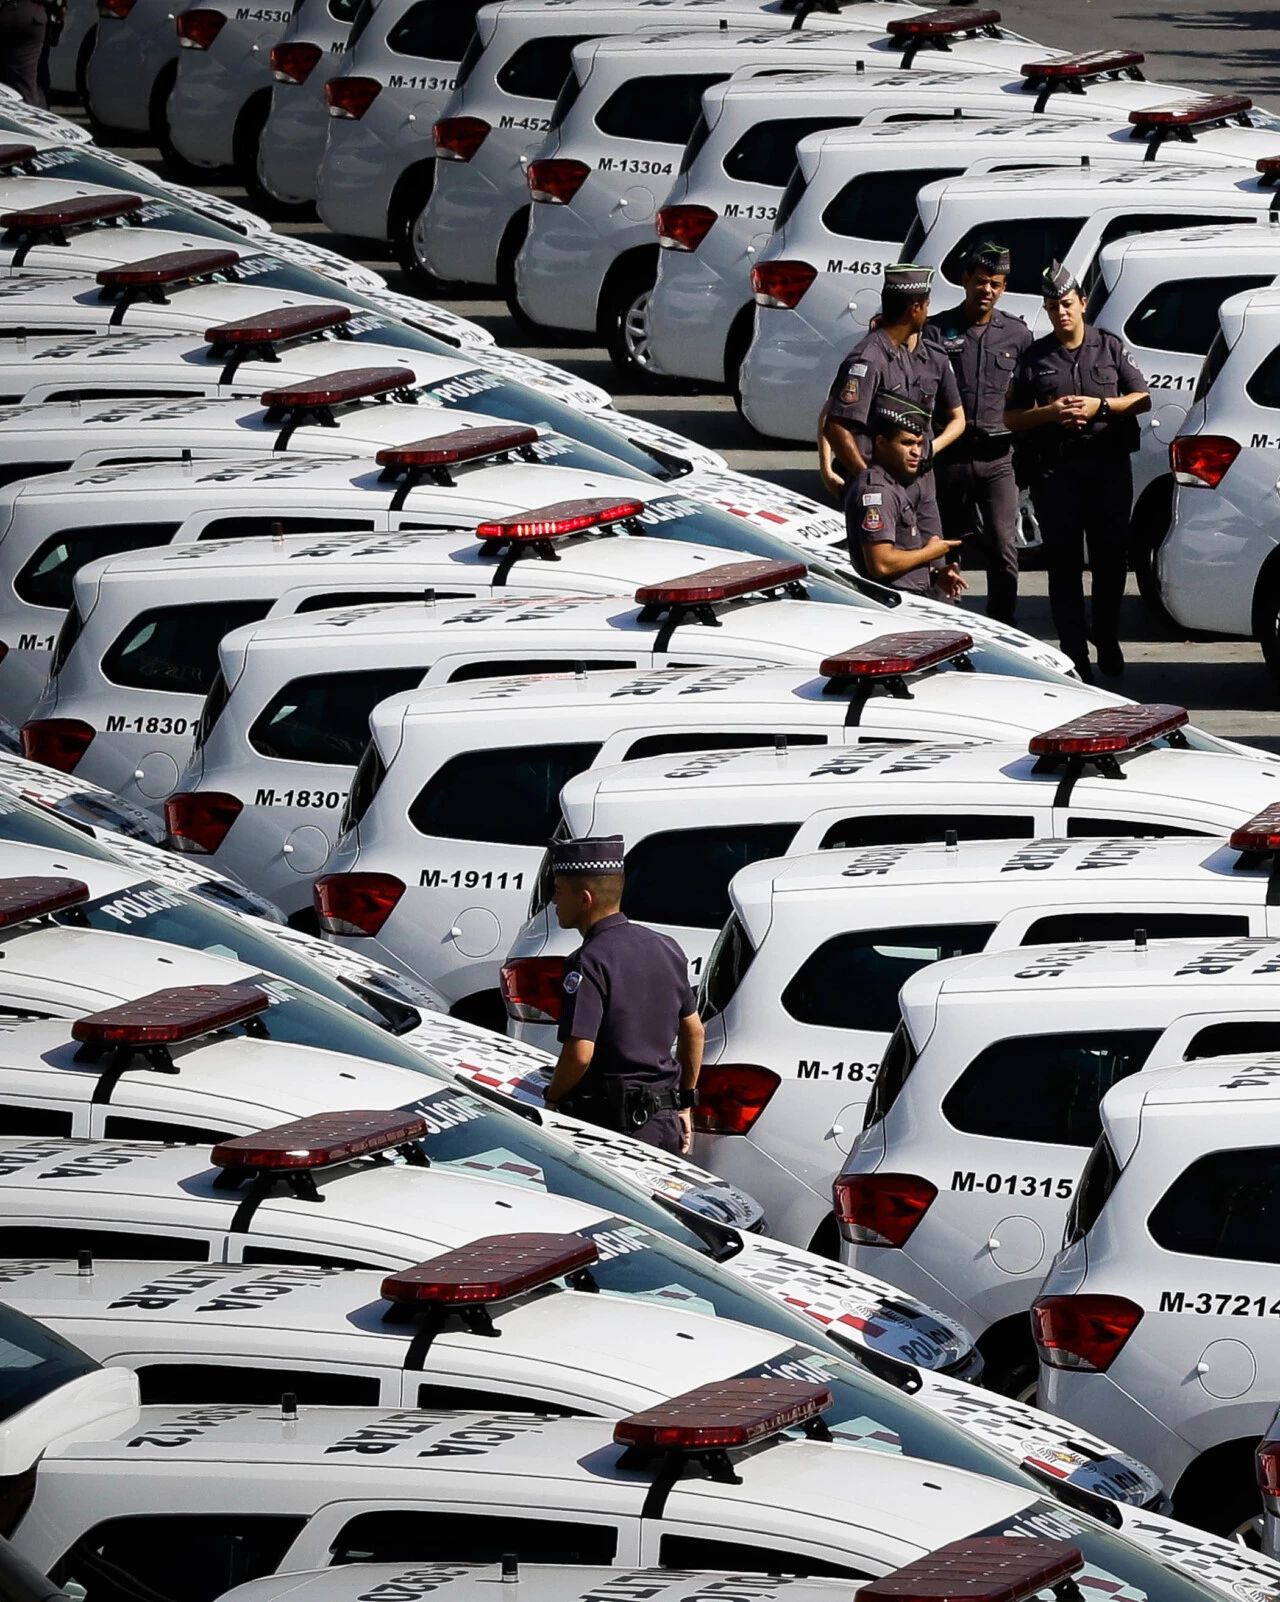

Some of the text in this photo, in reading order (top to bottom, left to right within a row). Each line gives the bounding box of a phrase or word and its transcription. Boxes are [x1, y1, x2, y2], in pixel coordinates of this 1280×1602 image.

[235, 8, 291, 24] M-4530
[500, 116, 550, 132] M-452
[598, 157, 672, 176] M-13304
[724, 204, 777, 220] M-133
[826, 259, 880, 276] M-463
[438, 373, 506, 403] POLÍCIA
[106, 715, 198, 737] M-18301
[419, 869, 524, 890] M-19111
[100, 886, 188, 925] POLÍCIA
[797, 1060, 878, 1083] M-183
[420, 1100, 487, 1135] OLÍCIA
[951, 1171, 1073, 1199] M-01315
[194, 1266, 341, 1314] OLÍCIA
[417, 1412, 563, 1458] OLÍCIA
